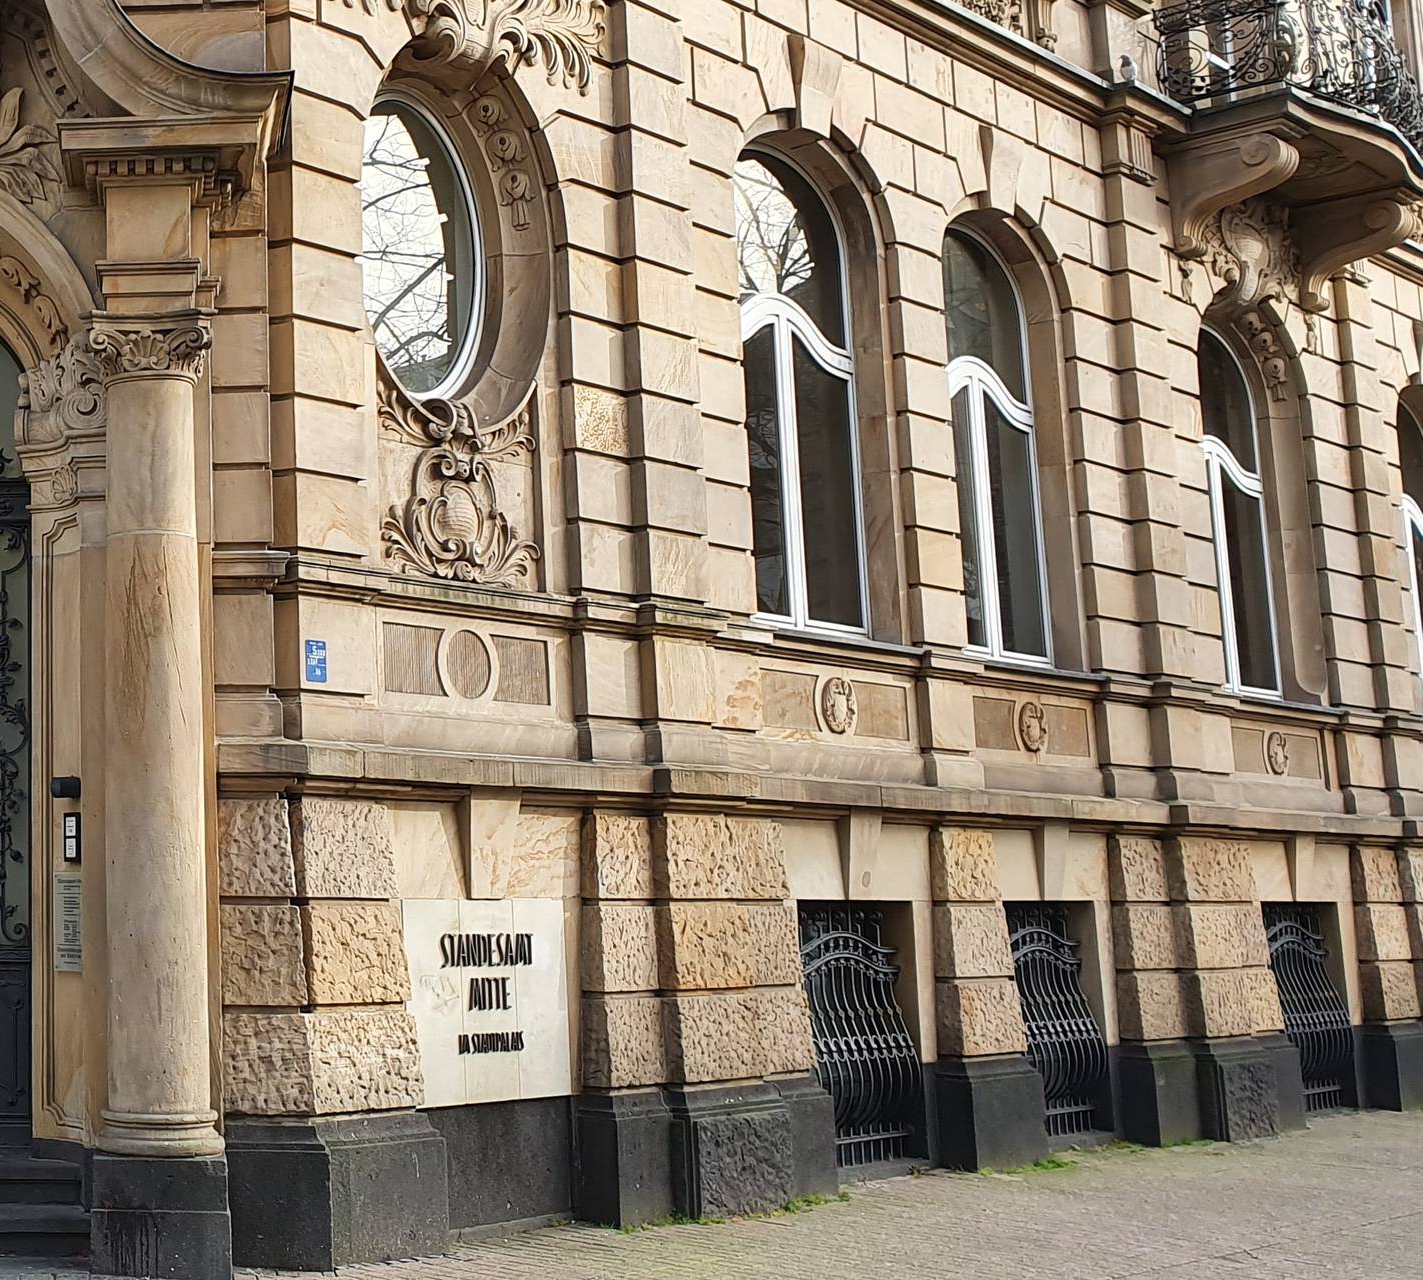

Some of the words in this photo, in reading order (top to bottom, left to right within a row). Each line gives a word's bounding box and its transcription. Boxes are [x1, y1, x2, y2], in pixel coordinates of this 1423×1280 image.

[439, 932, 534, 969] STANDESAMT
[468, 976, 512, 1012] MITTE
[471, 1030, 525, 1055] STADTPALAIS
